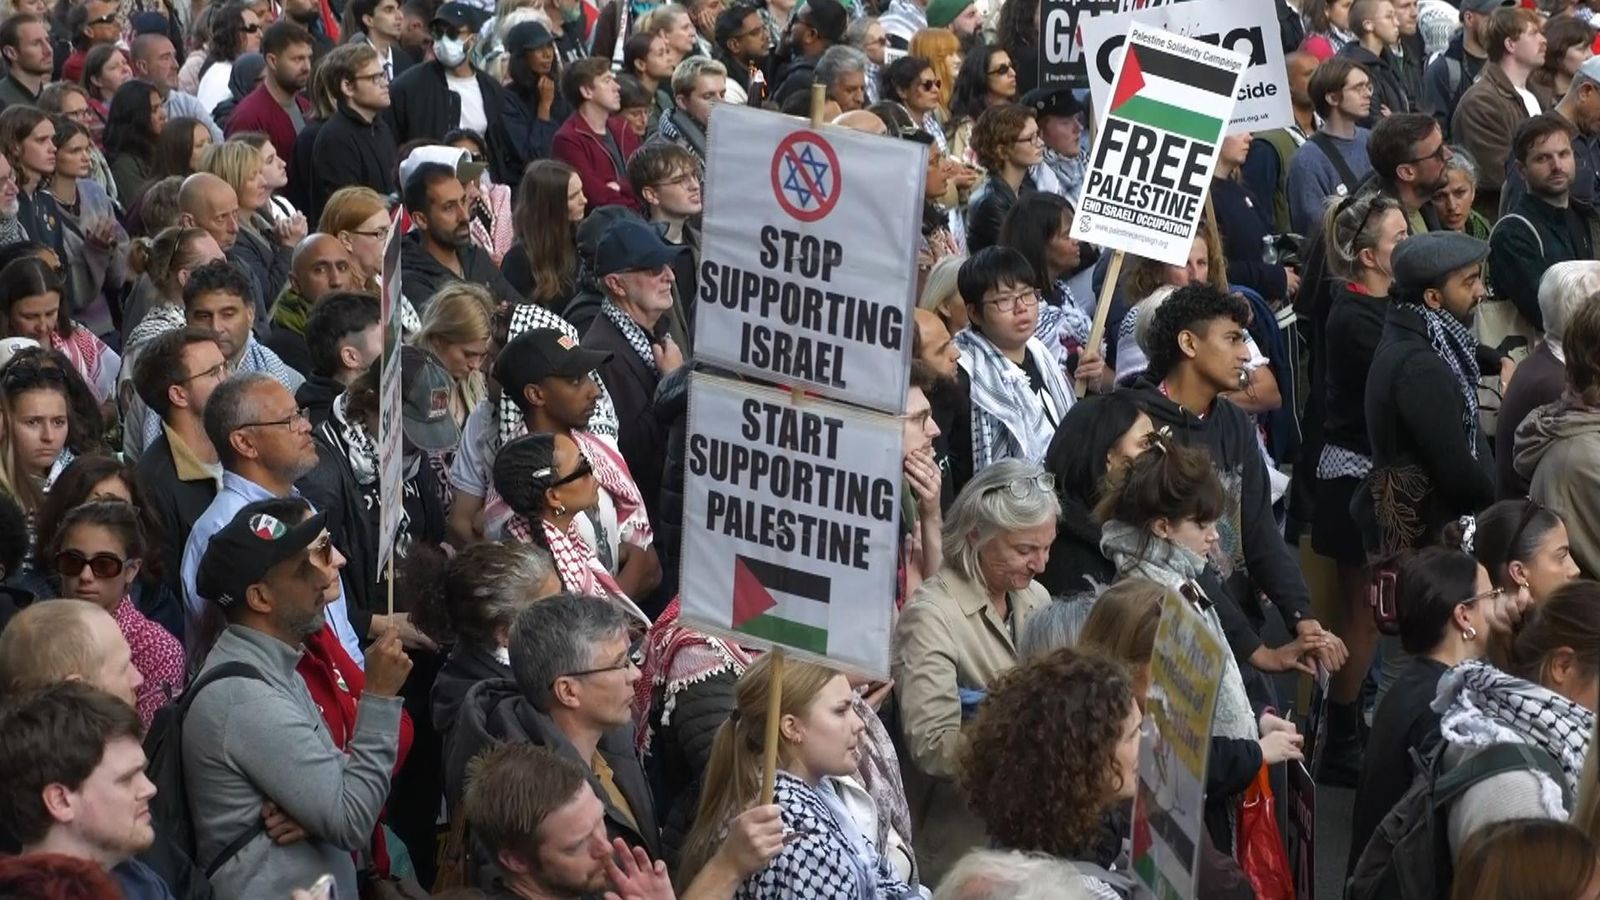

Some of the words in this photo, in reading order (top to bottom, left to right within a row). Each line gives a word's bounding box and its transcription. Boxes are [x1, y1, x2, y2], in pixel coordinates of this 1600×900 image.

[1131, 29, 1166, 47] Palestine
[1166, 39, 1202, 59] Solidarity
[1203, 51, 1242, 70] Campaign
[1237, 82, 1277, 101] cide
[1093, 117, 1215, 197] FREE
[1083, 198, 1102, 212] END
[1102, 203, 1136, 222] ISRAELI
[1136, 213, 1190, 237] OCCUPATION
[1086, 170, 1199, 222] PALESTINE
[760, 225, 843, 283] STOP
[700, 260, 903, 351] SUPPORTING
[740, 322, 847, 389] ISRAEL
[741, 398, 843, 460] START
[689, 433, 894, 522] SUPPORTING
[706, 489, 871, 570] PALESTINE
